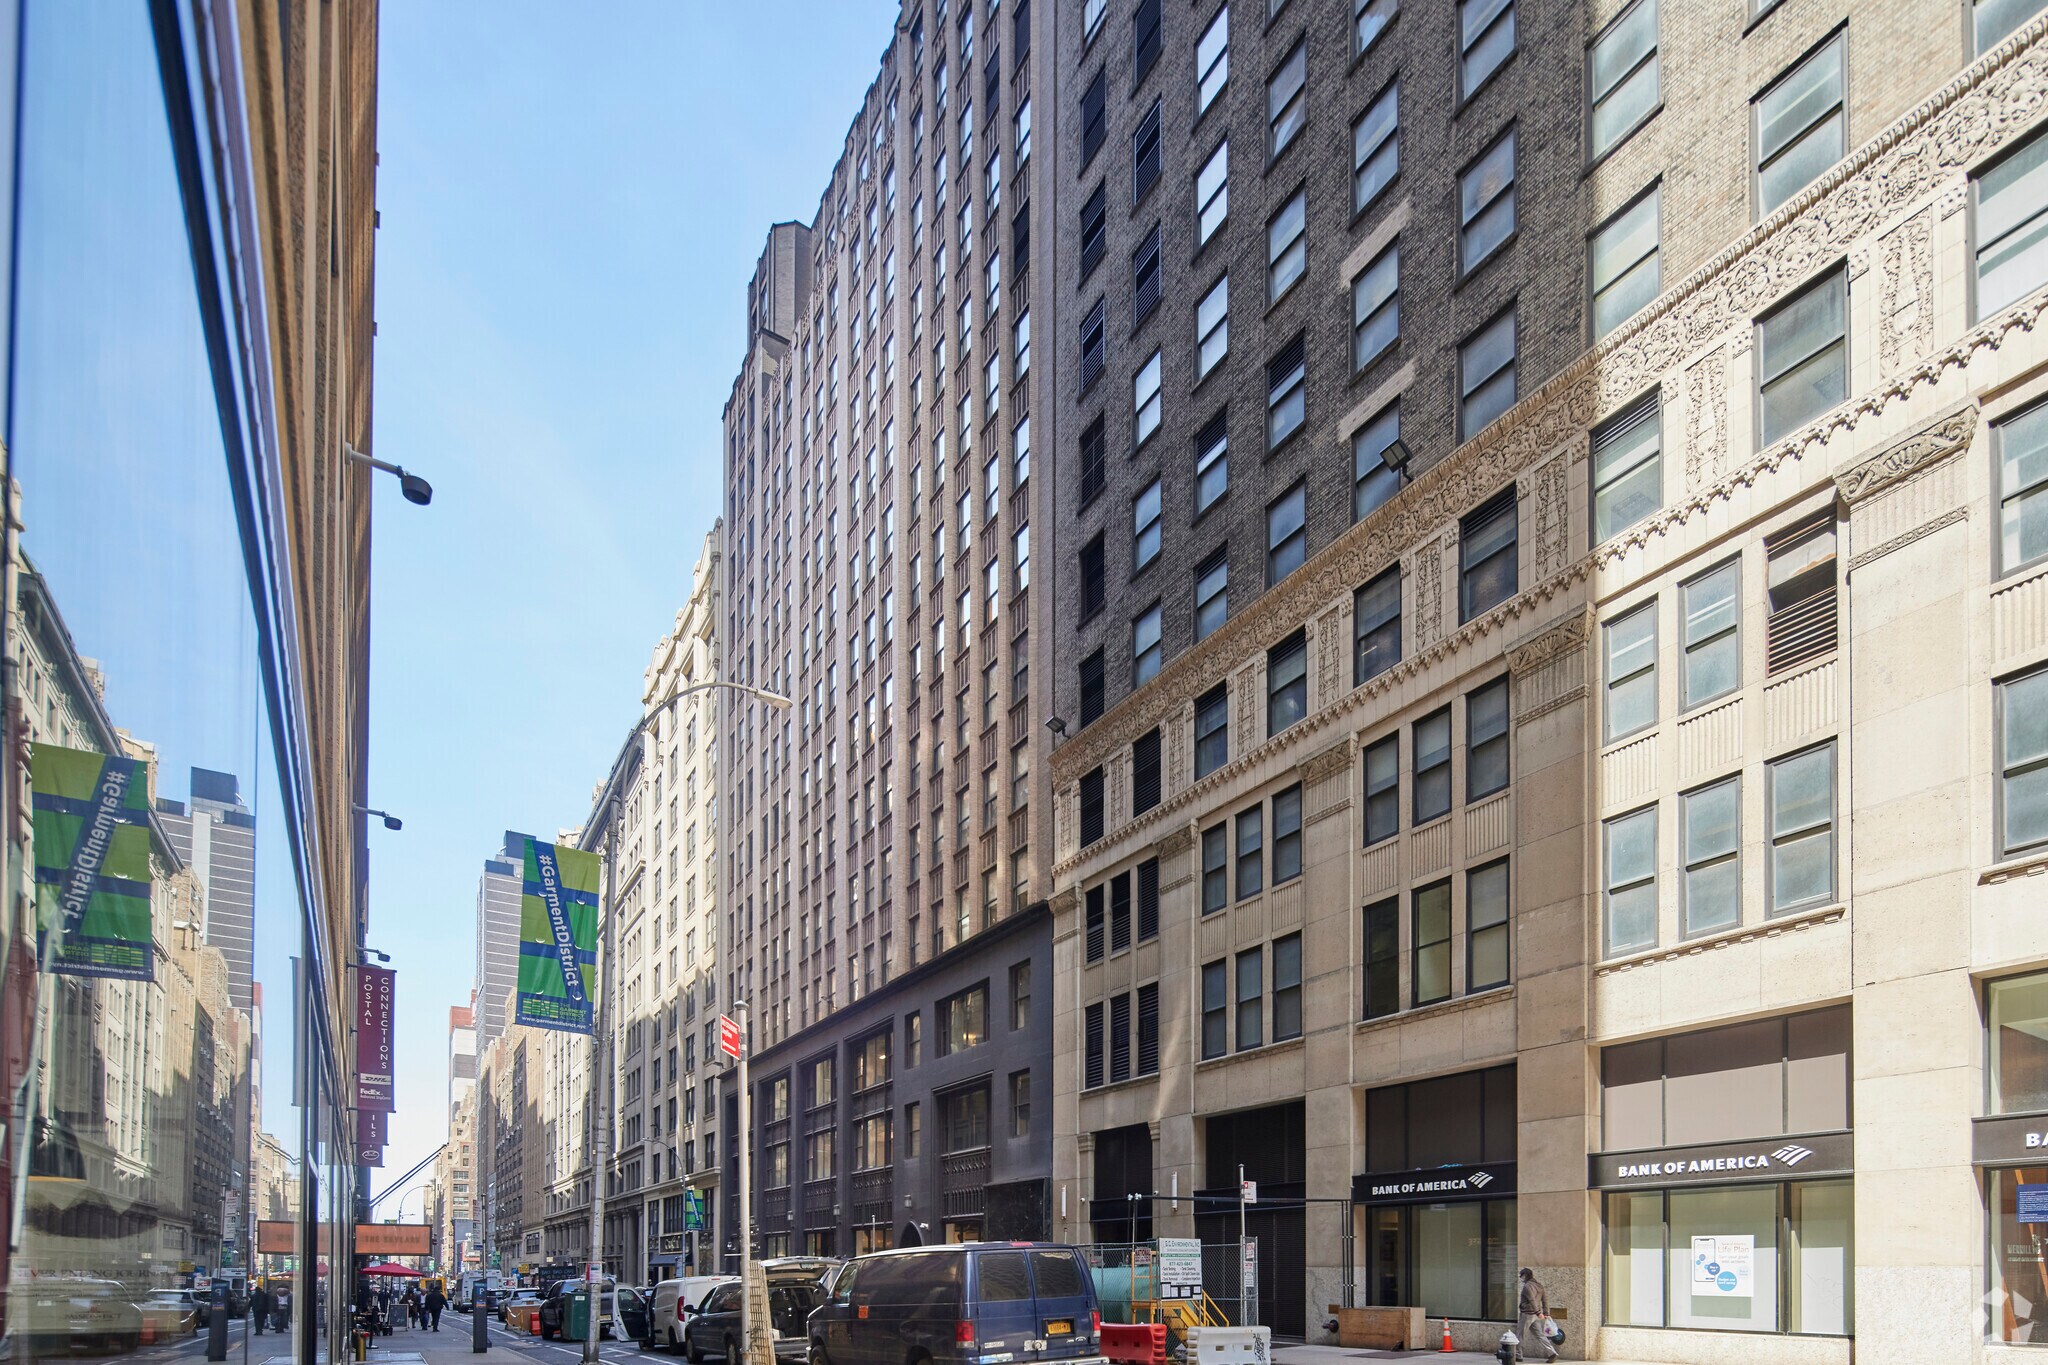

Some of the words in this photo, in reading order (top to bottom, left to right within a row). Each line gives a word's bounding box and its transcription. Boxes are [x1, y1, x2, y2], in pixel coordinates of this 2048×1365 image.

[539, 855, 579, 987] #GarmentDistrict
[364, 975, 373, 1026] POSTAL
[380, 977, 390, 1069] CONNECTIONS
[360, 1088, 381, 1096] FedEx
[1618, 1163, 1662, 1178] BANK
[1664, 1161, 1686, 1174] OF
[1688, 1155, 1769, 1173] AMERICA
[1372, 1185, 1400, 1196] BANK
[1401, 1183, 1416, 1193] OF
[1416, 1179, 1467, 1193] AMERICA
